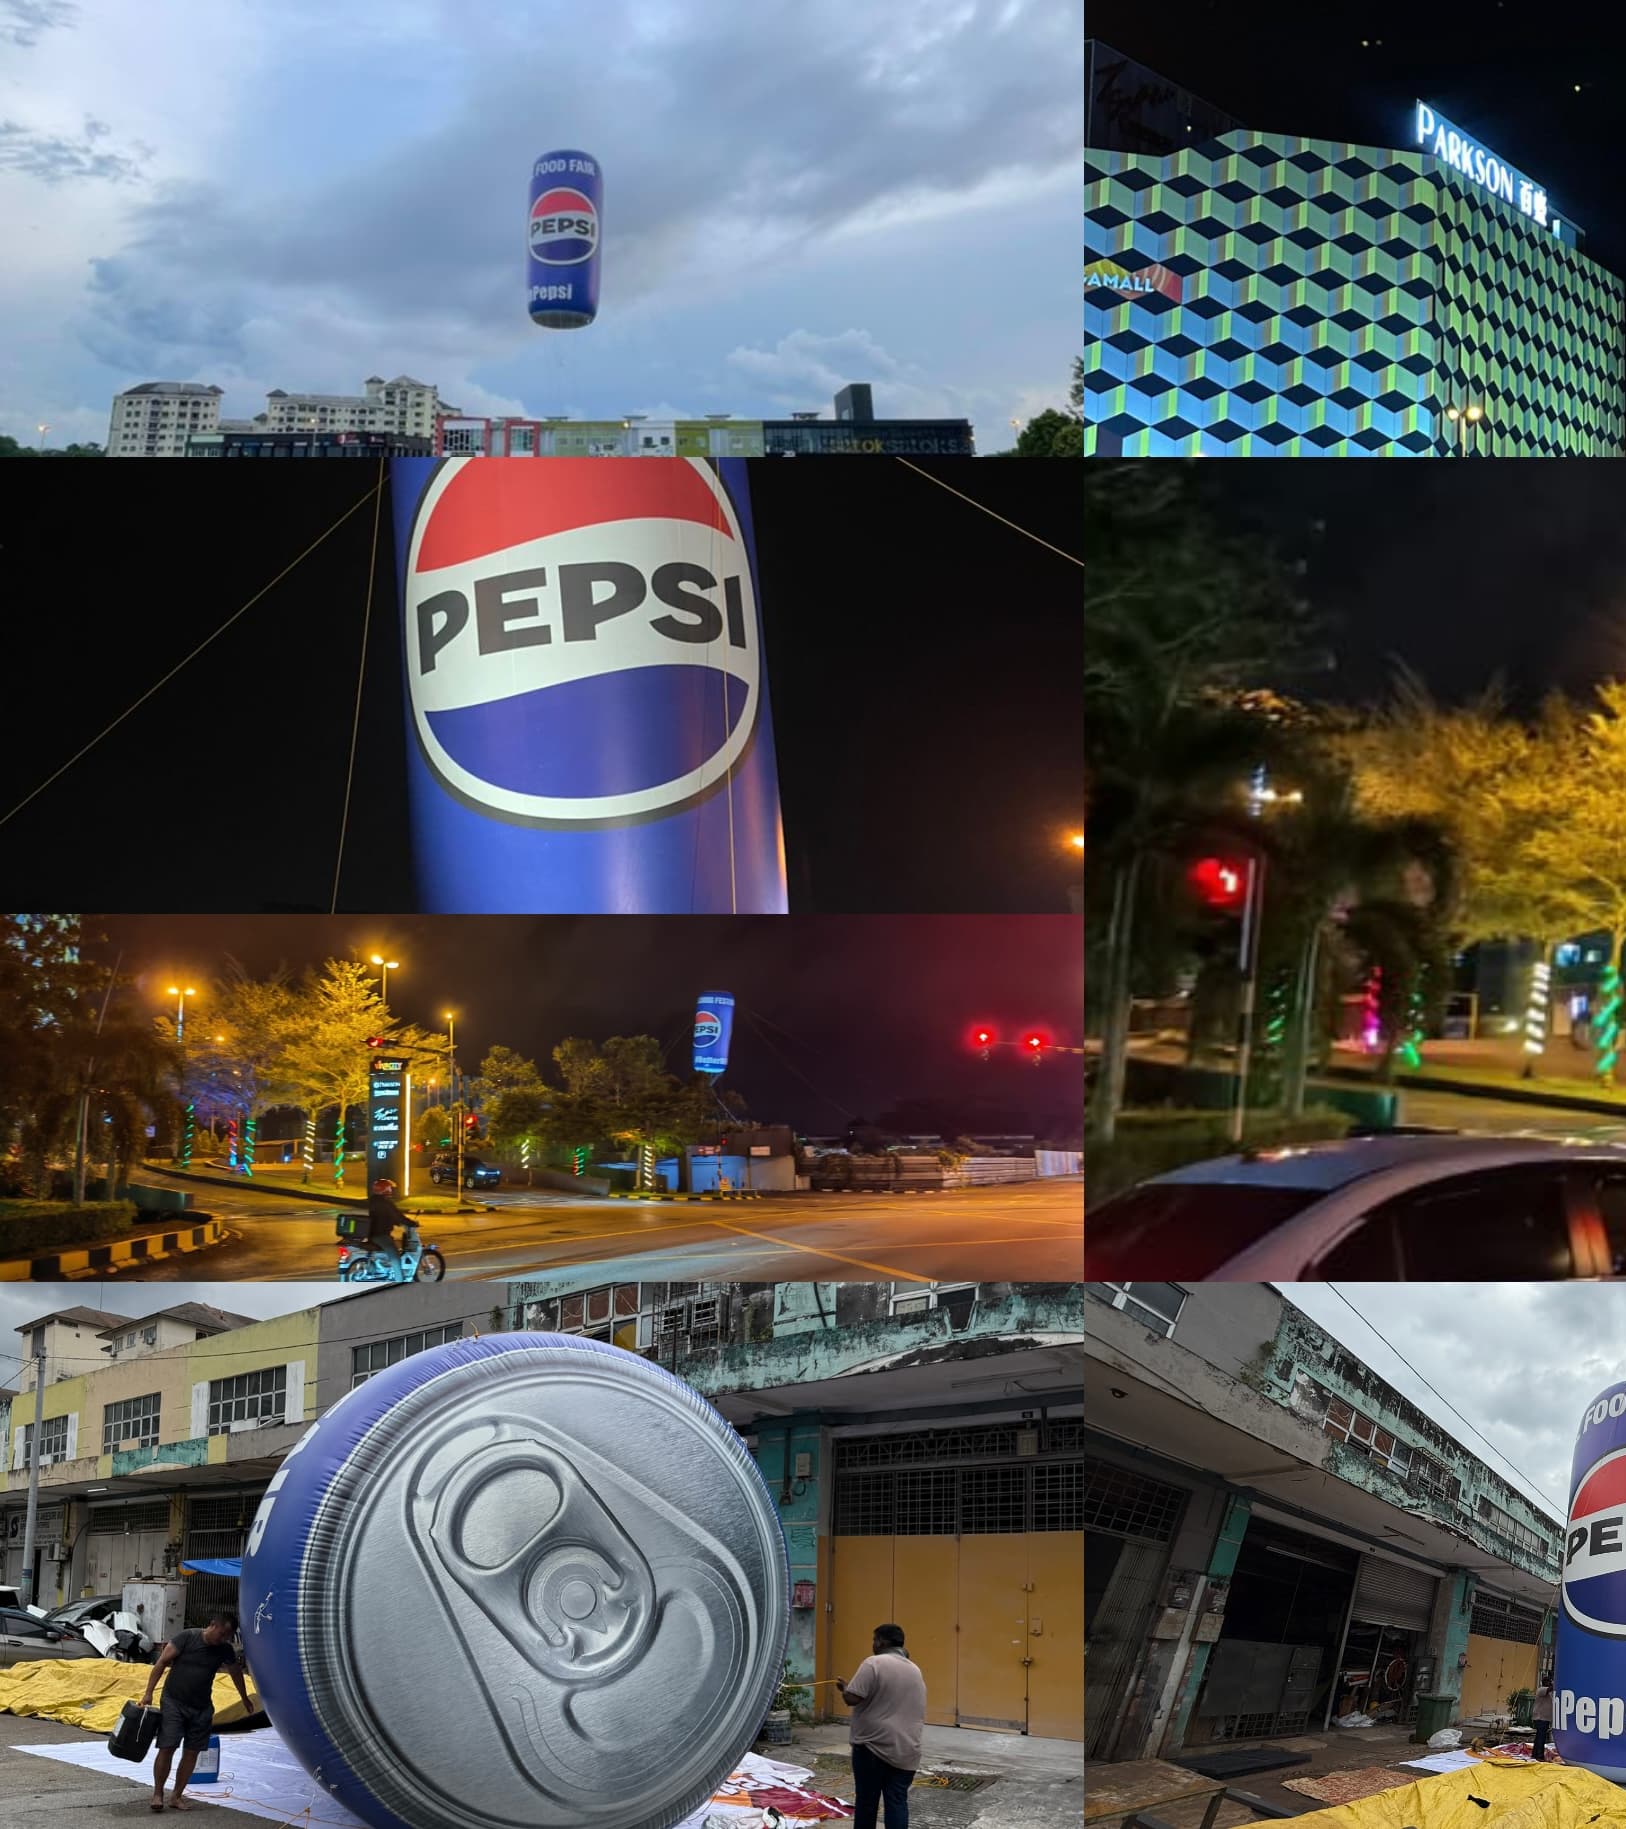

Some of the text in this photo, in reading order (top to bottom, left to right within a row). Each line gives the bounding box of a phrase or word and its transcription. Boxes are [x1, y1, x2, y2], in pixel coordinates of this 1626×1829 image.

[535, 159, 595, 176] FOOD FAIR
[1418, 103, 1513, 203] PARKSON
[531, 218, 596, 238] PEPSI
[416, 561, 747, 676] PEPSI
